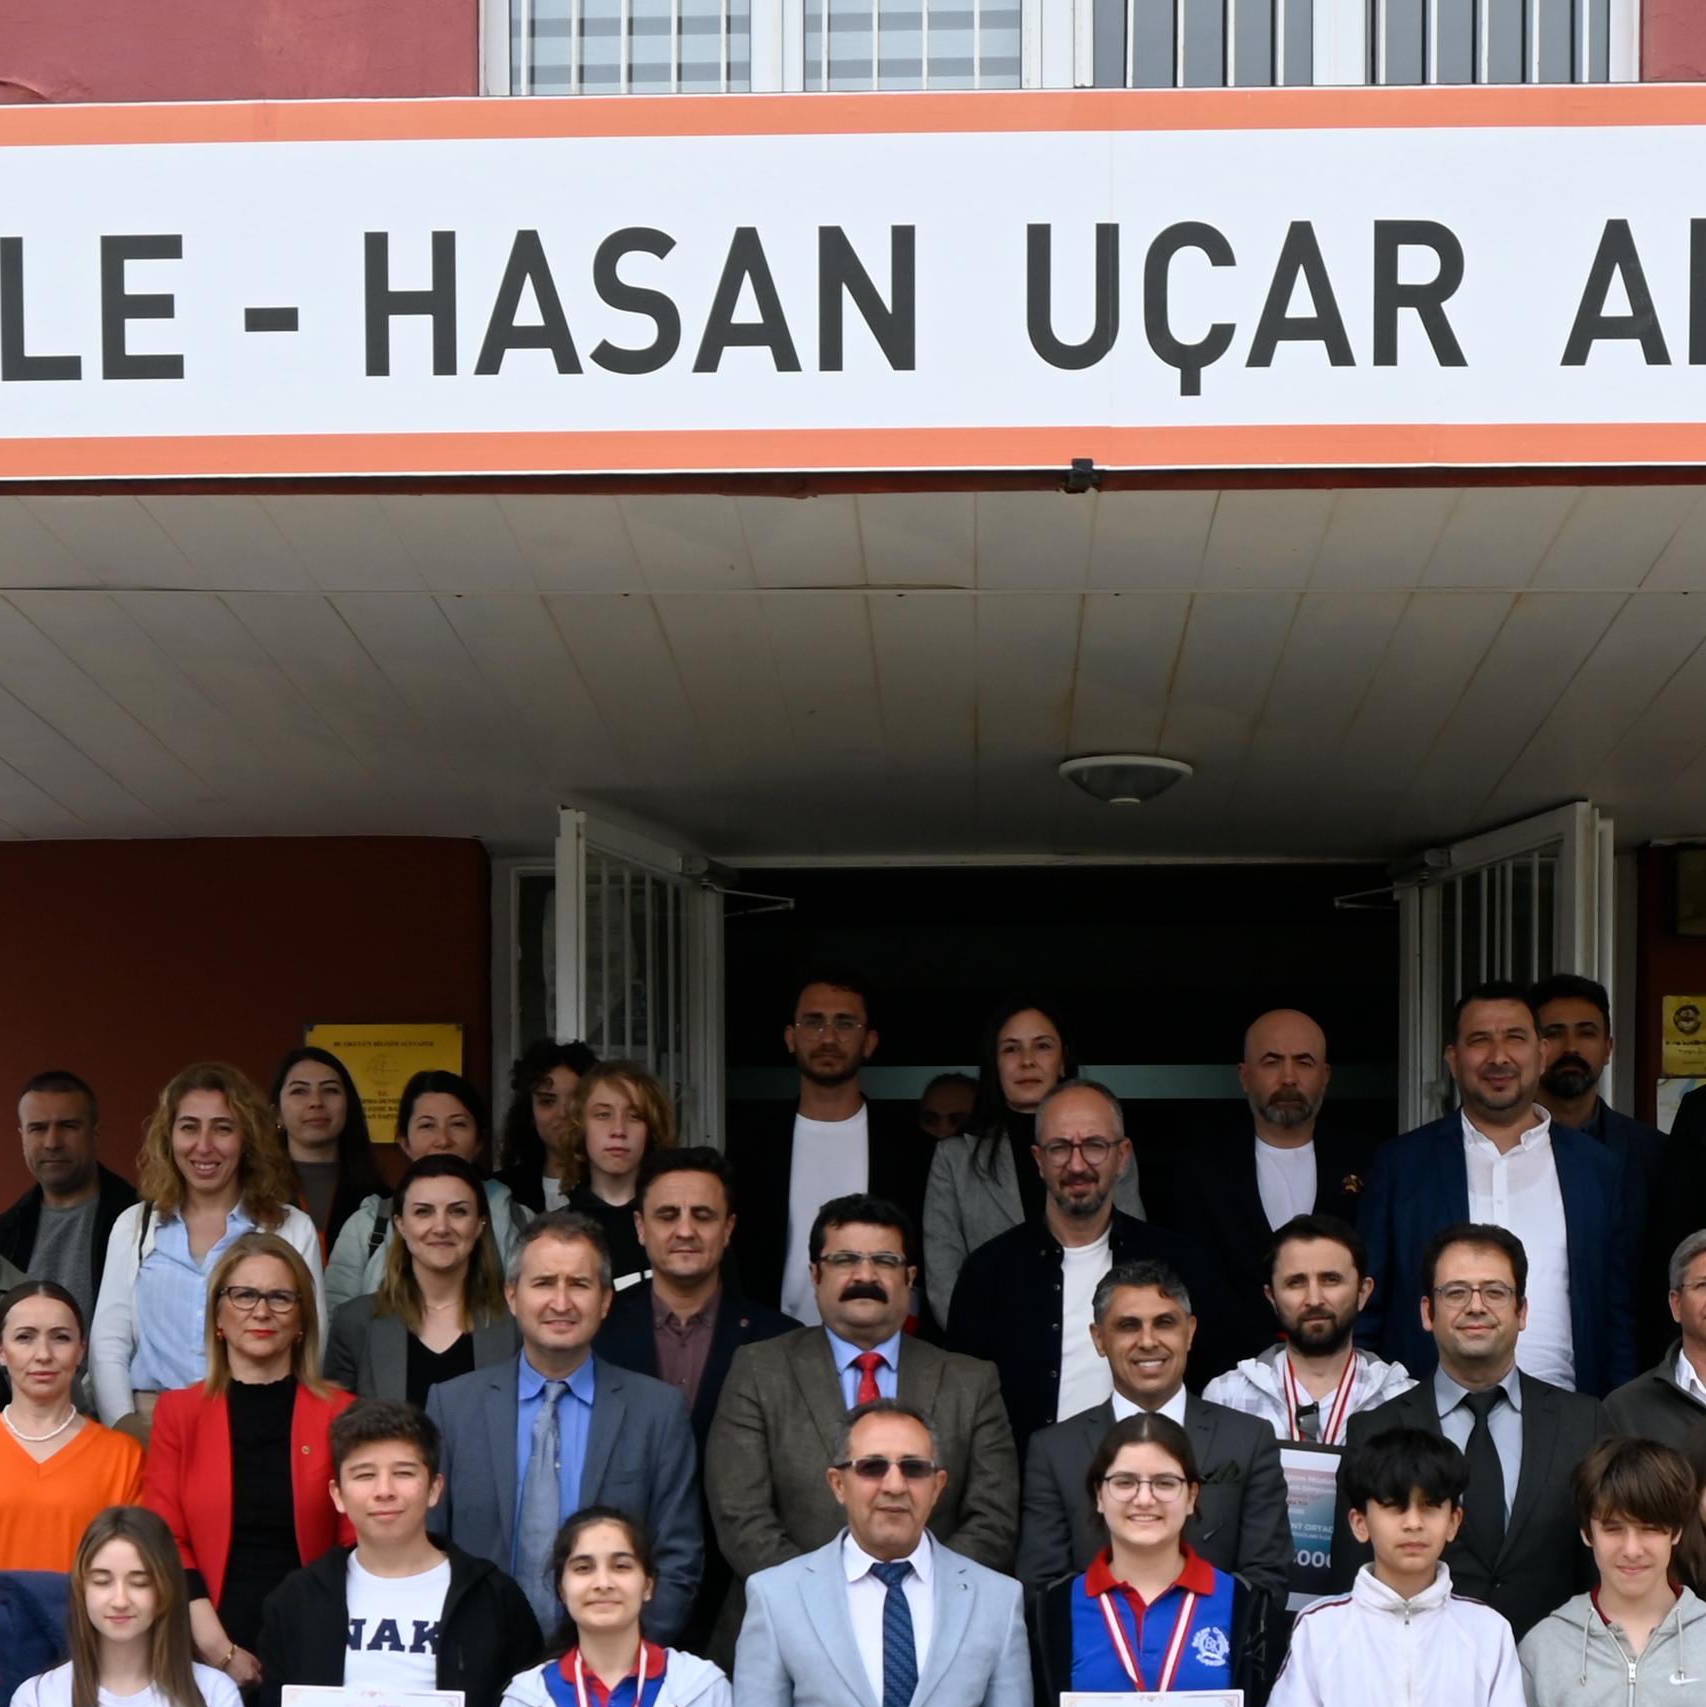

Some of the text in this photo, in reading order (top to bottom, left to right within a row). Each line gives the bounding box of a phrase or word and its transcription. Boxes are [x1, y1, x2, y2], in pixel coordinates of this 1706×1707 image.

[244, 307, 299, 333] -
[364, 226, 916, 377] HASAN
[1026, 220, 1469, 397] UÇAR
